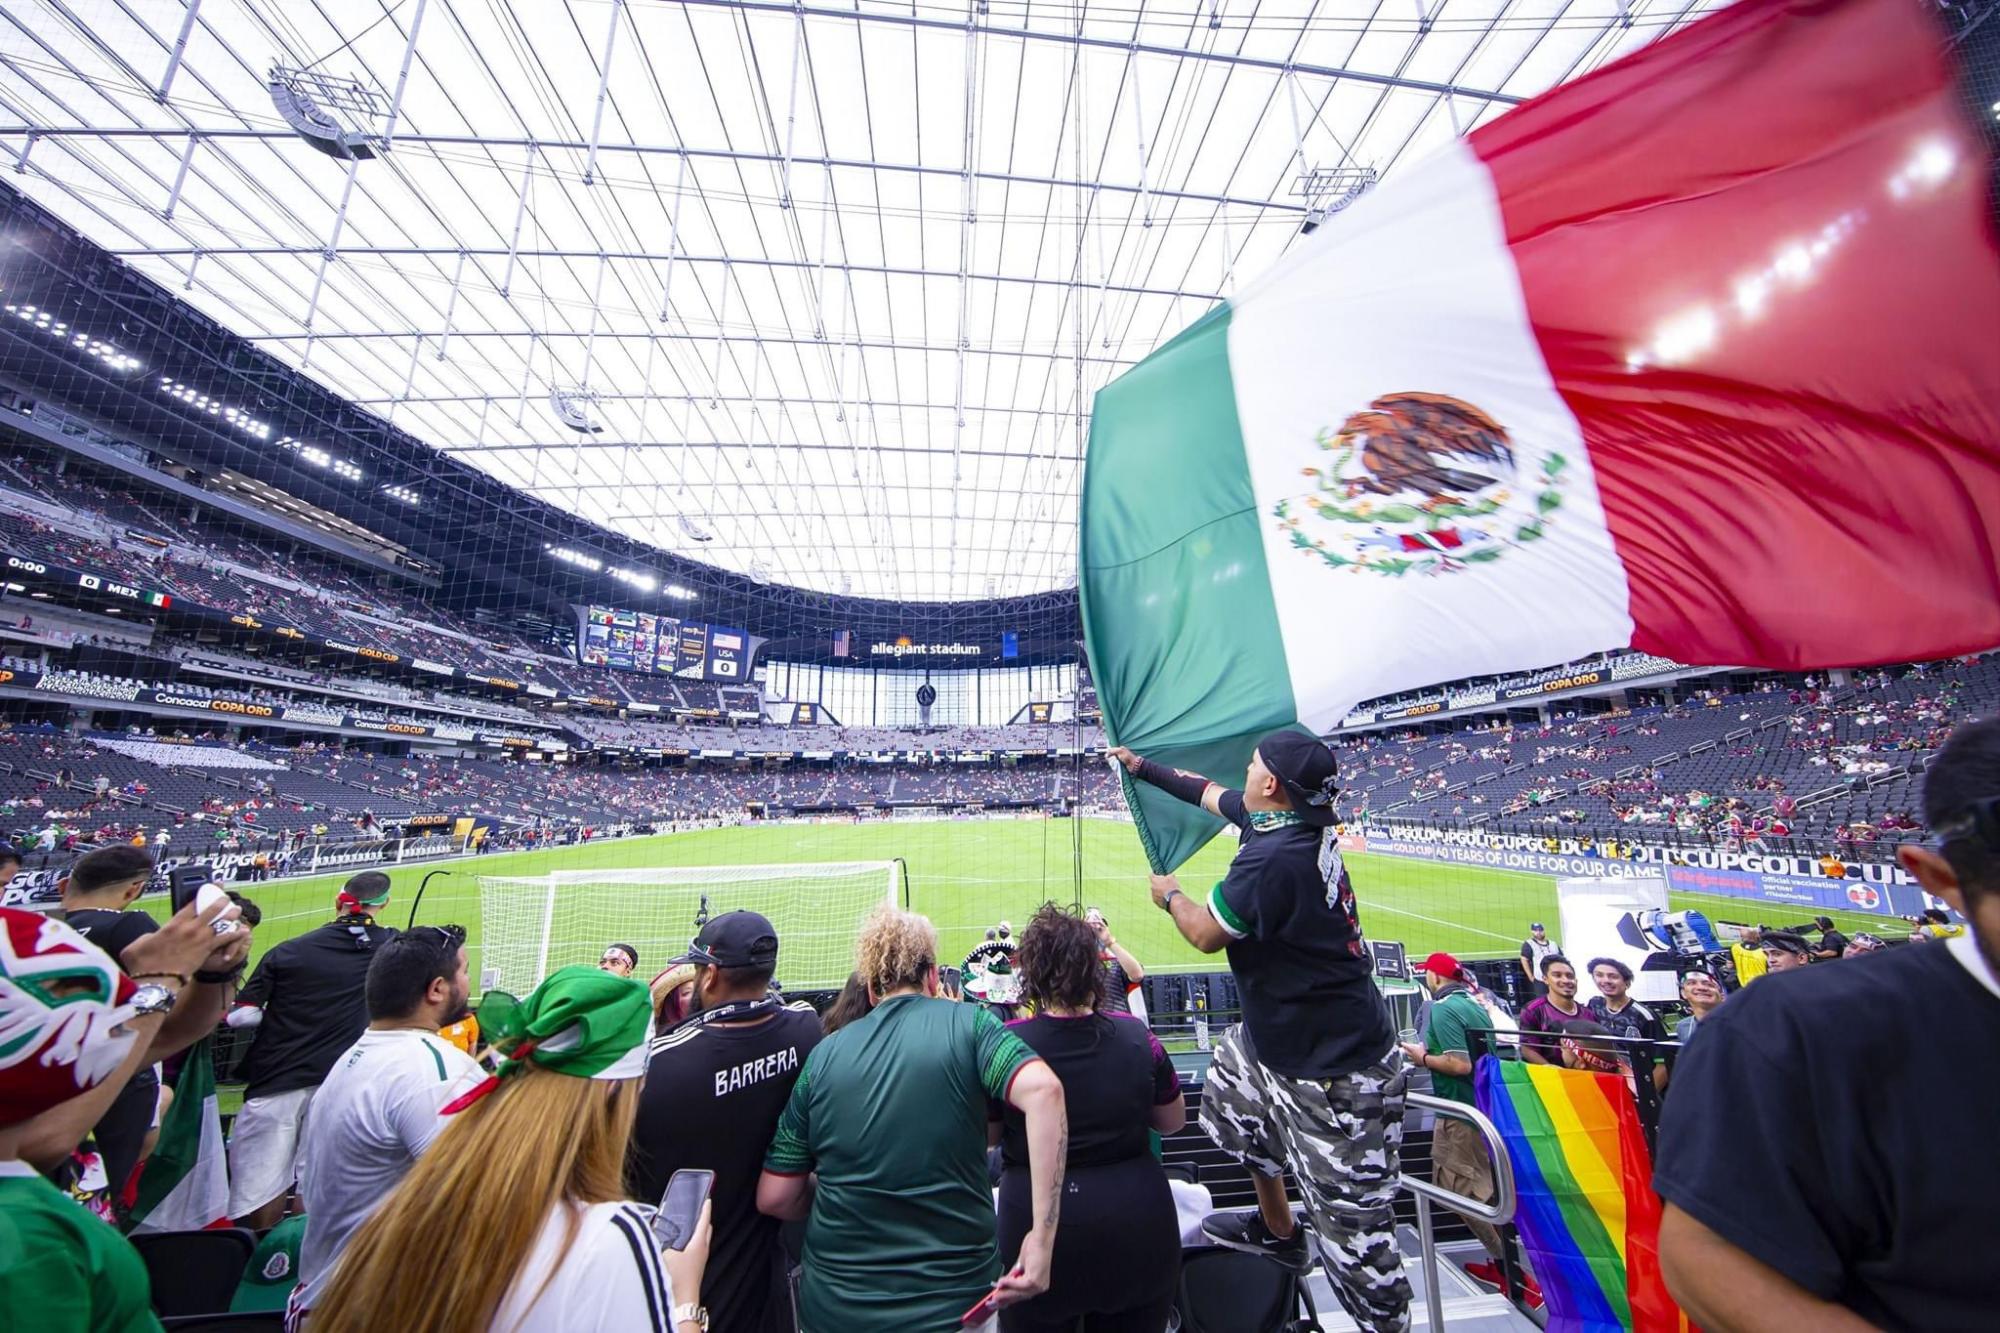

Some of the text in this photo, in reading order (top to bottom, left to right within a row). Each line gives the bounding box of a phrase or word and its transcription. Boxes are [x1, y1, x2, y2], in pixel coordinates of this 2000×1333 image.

[8, 557, 46, 574] 0:00
[107, 583, 140, 599] MEX
[360, 647, 382, 659] GOLD
[382, 652, 399, 662] CUP
[718, 649, 734, 658] USA
[871, 641, 981, 656] allegiant stadium
[1506, 672, 1599, 698] Concacaf COPA ORO
[156, 692, 272, 717] Concacaf COPA ORO
[1406, 706, 1426, 716] GOLD
[1426, 703, 1440, 712] CUP
[388, 723, 409, 734] GOLD
[410, 726, 426, 736] CUP
[412, 816, 433, 826] GOLD
[434, 815, 448, 824] CUP
[1393, 842, 1416, 854] GOLD
[1416, 844, 1434, 856] CUP
[1450, 848, 1485, 864] YEARS
[1486, 852, 1503, 865] OF
[1504, 853, 1538, 869] LOVE
[1539, 856, 1570, 873] FOR
[1570, 860, 1606, 877] OUR
[1608, 862, 1664, 879] GAME
[1761, 876, 1840, 890] Official vaccination
[715, 1046, 798, 1096] BARRERA
